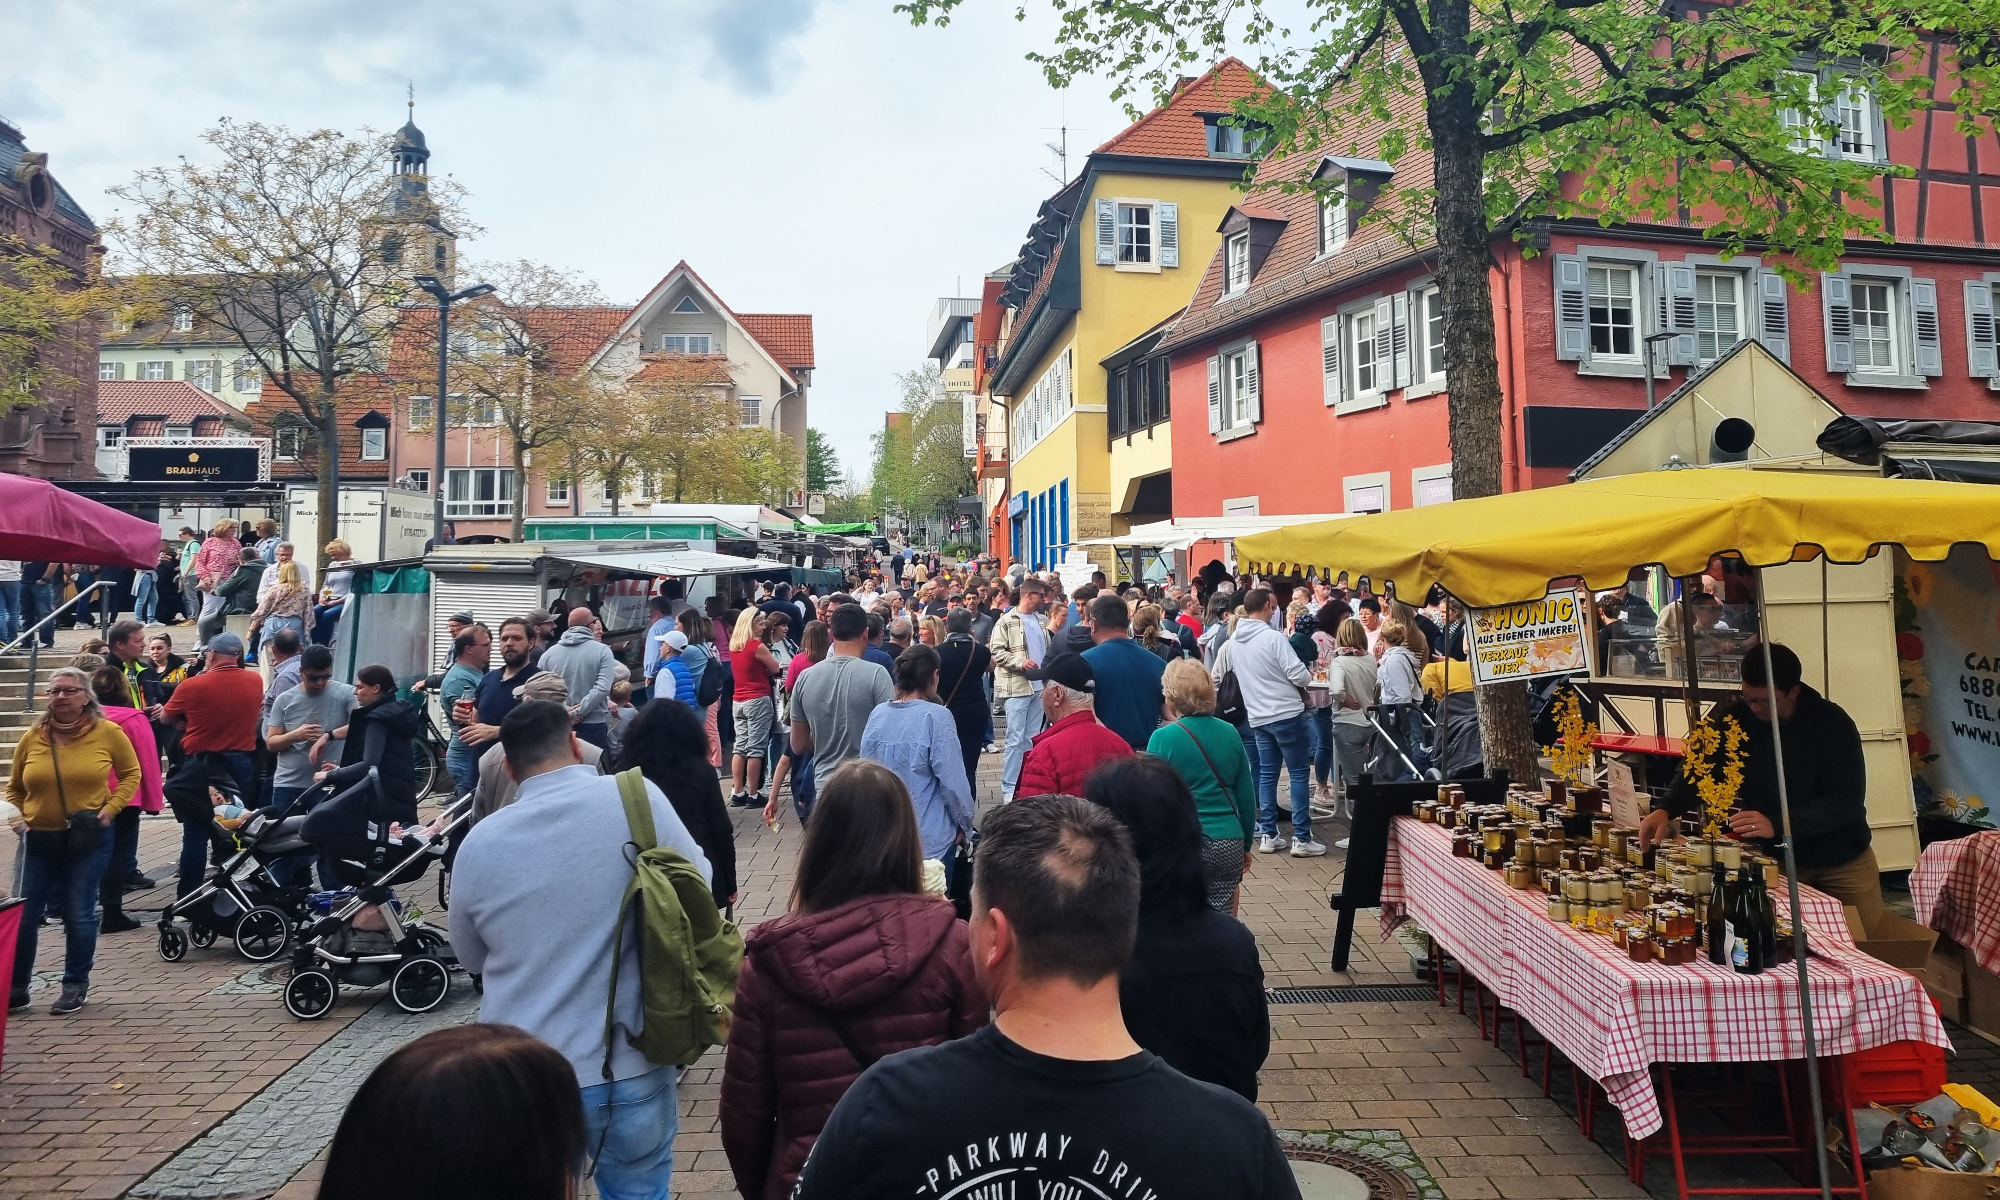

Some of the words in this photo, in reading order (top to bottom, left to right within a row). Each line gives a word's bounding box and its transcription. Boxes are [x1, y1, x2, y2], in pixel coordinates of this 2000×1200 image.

[166, 466, 221, 475] BRAUHAUS
[1494, 597, 1574, 630] HONIG
[1477, 634, 1494, 645] AUS
[1496, 629, 1536, 642] EIGENER
[1538, 623, 1577, 637] IMKEREI
[1479, 645, 1530, 664] VERKAUF
[1493, 662, 1521, 675] HIER
[1963, 698, 1995, 722] TEL.
